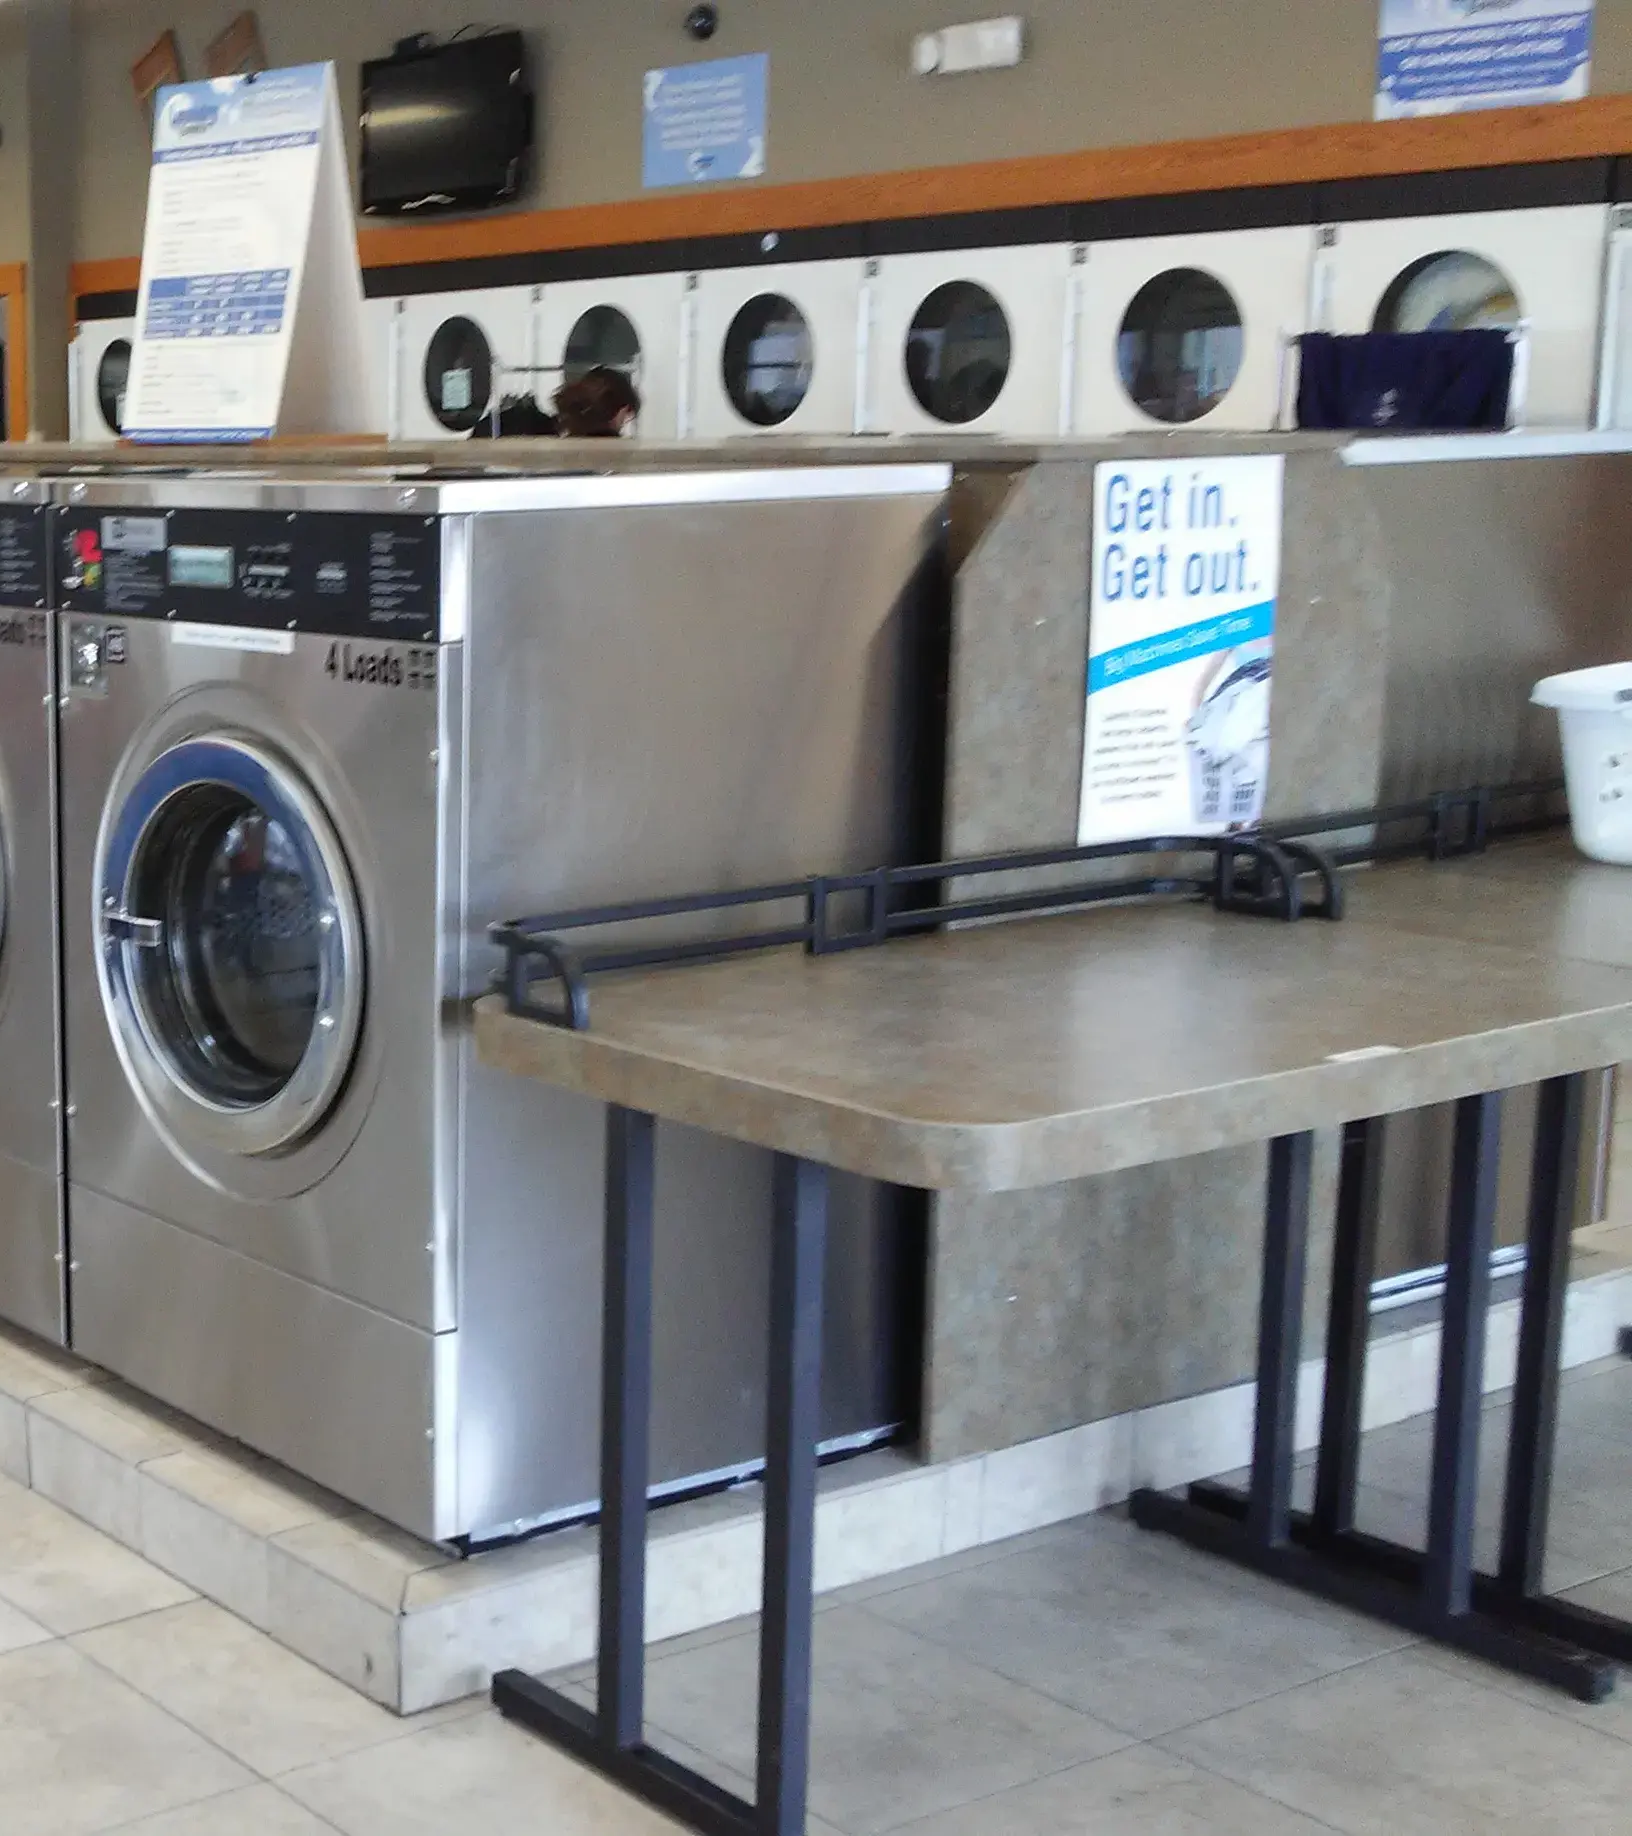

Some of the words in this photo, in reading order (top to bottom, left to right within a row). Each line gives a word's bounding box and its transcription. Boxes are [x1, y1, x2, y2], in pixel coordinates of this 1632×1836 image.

[1106, 473, 1174, 533] Get
[1188, 471, 1238, 529] in.
[1103, 542, 1169, 602] Get
[1184, 539, 1260, 597] out.
[325, 640, 340, 680] 4
[343, 643, 405, 687] Loads
